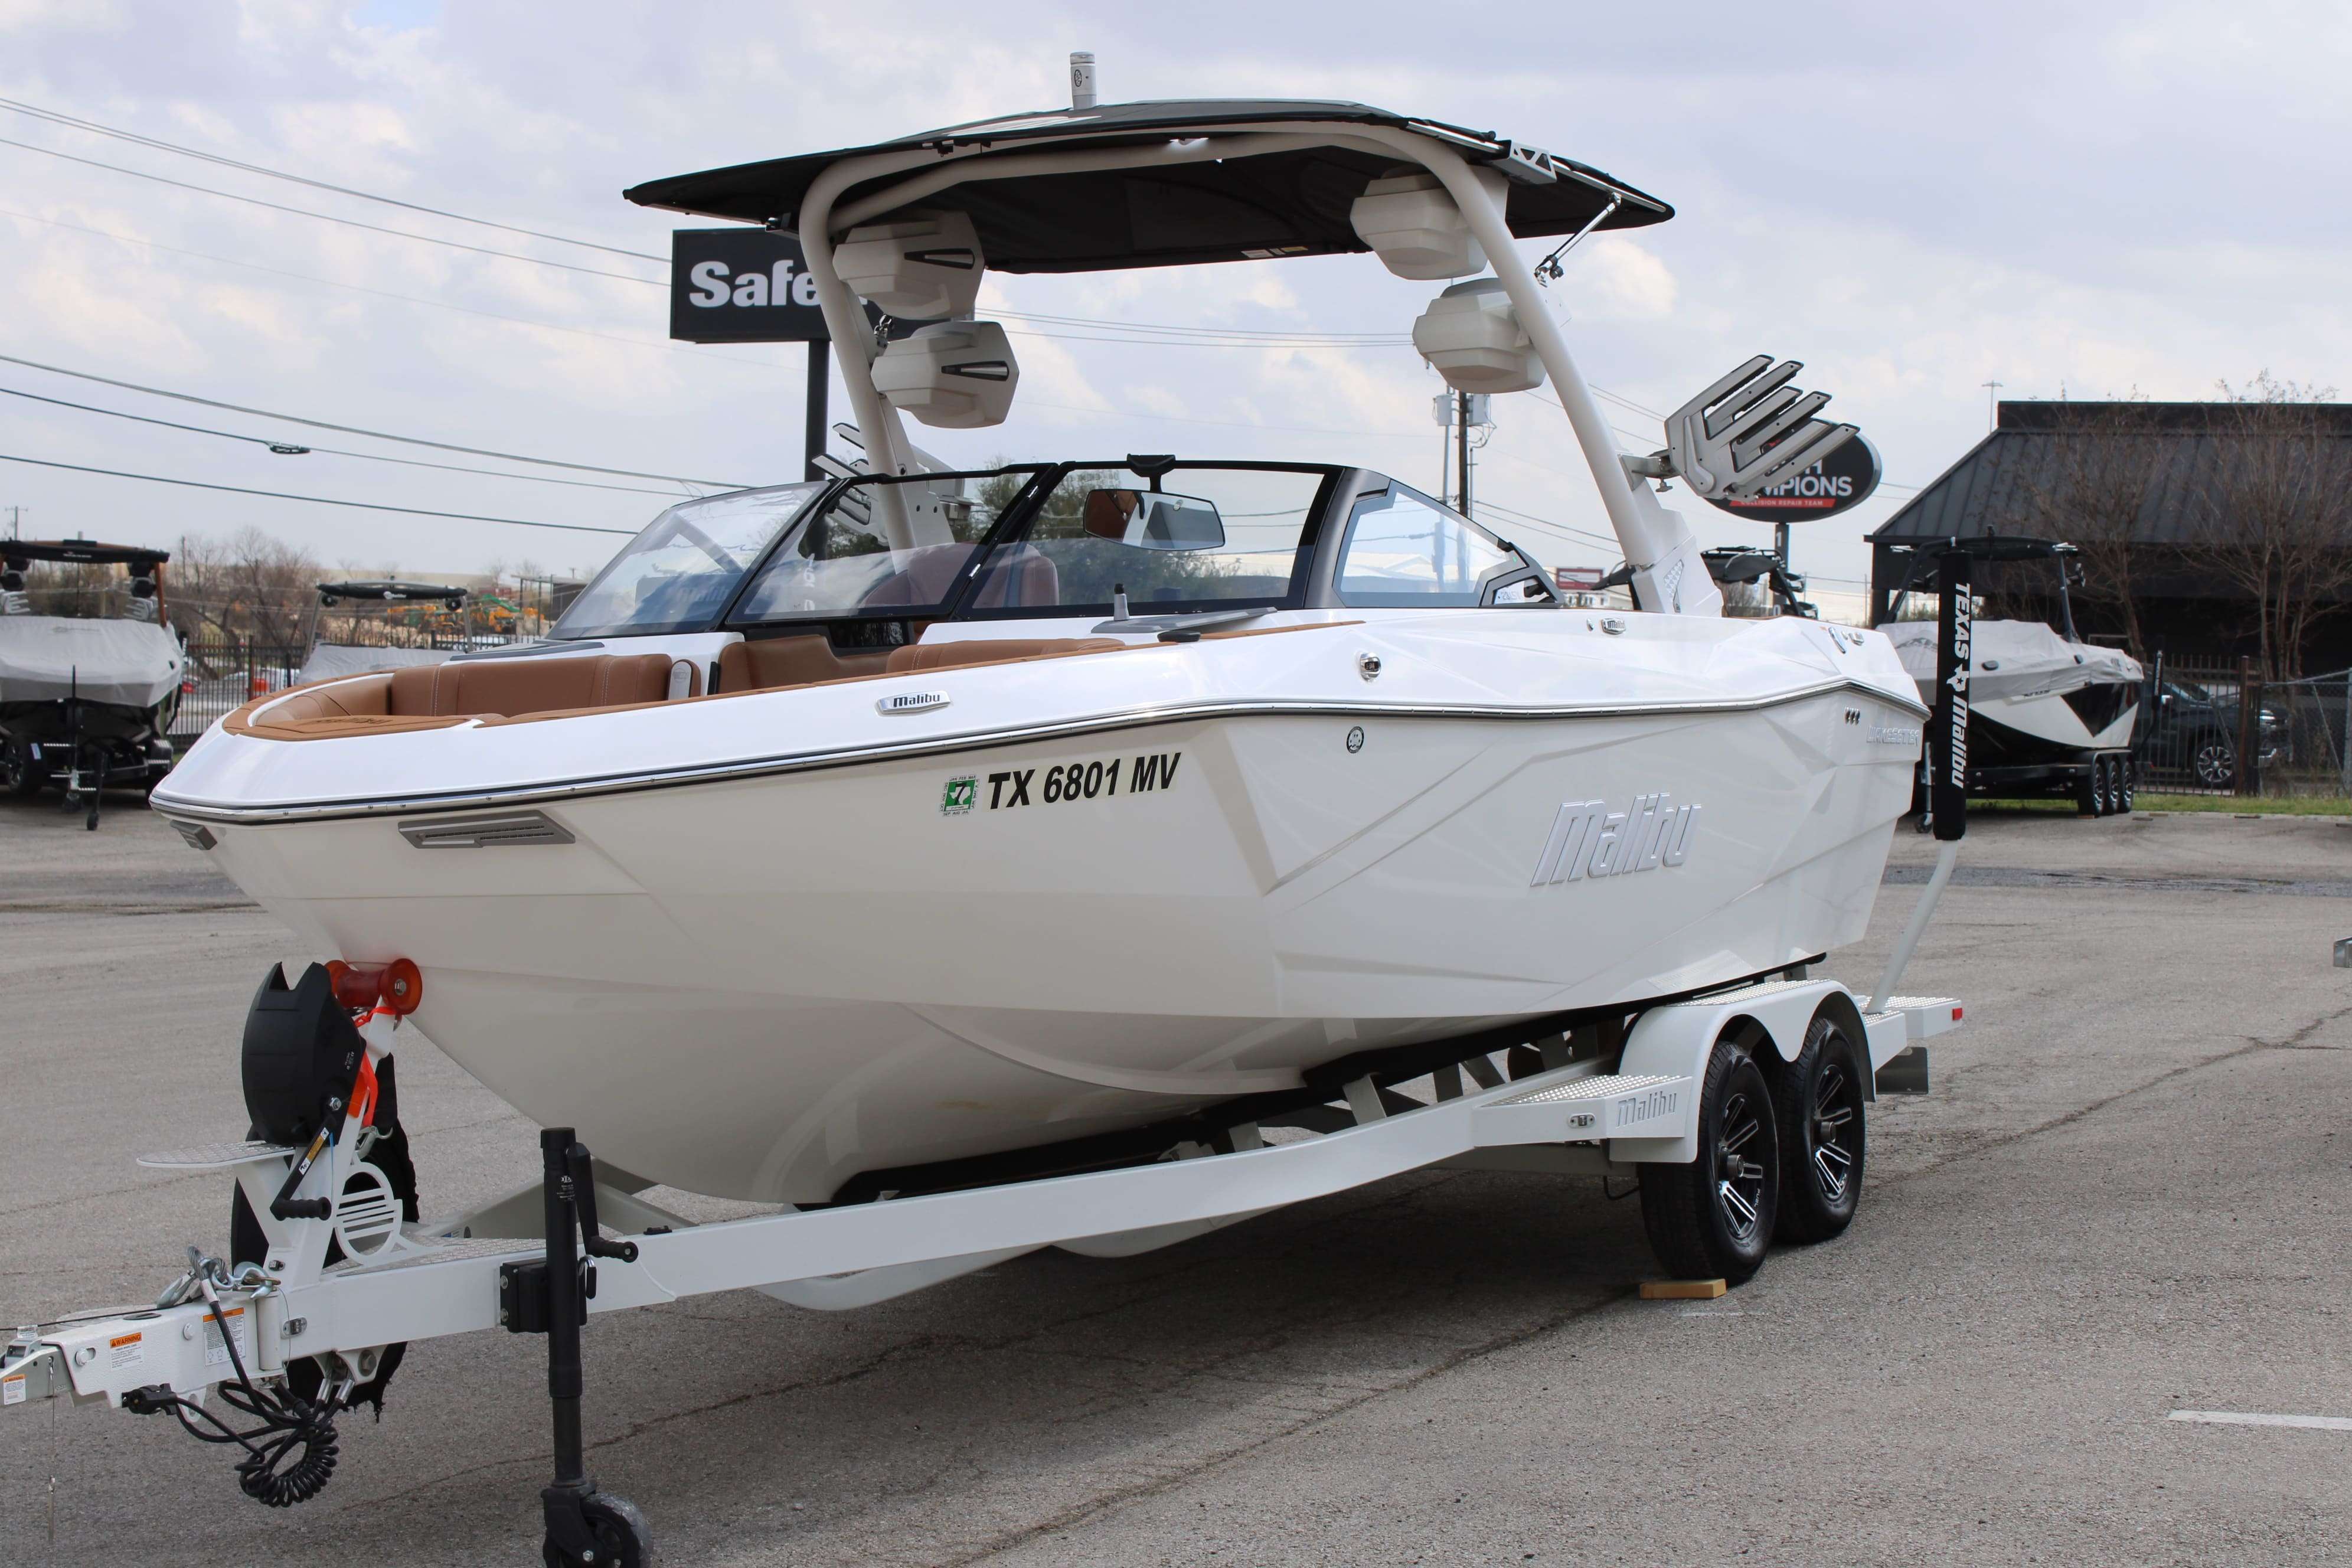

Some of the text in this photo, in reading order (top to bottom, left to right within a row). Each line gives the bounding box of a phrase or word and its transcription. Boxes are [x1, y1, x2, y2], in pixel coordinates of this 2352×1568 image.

[689, 259, 868, 308] Safe
[893, 693, 940, 708] Malibu
[1952, 582, 1971, 789] TEXAS Malibu
[954, 782, 967, 805] 7
[988, 752, 1181, 809] TX 6801 MV
[1530, 792, 1702, 887] Malibu
[1617, 1090, 1677, 1127] Malibu
[116, 1334, 141, 1345] WARNING
